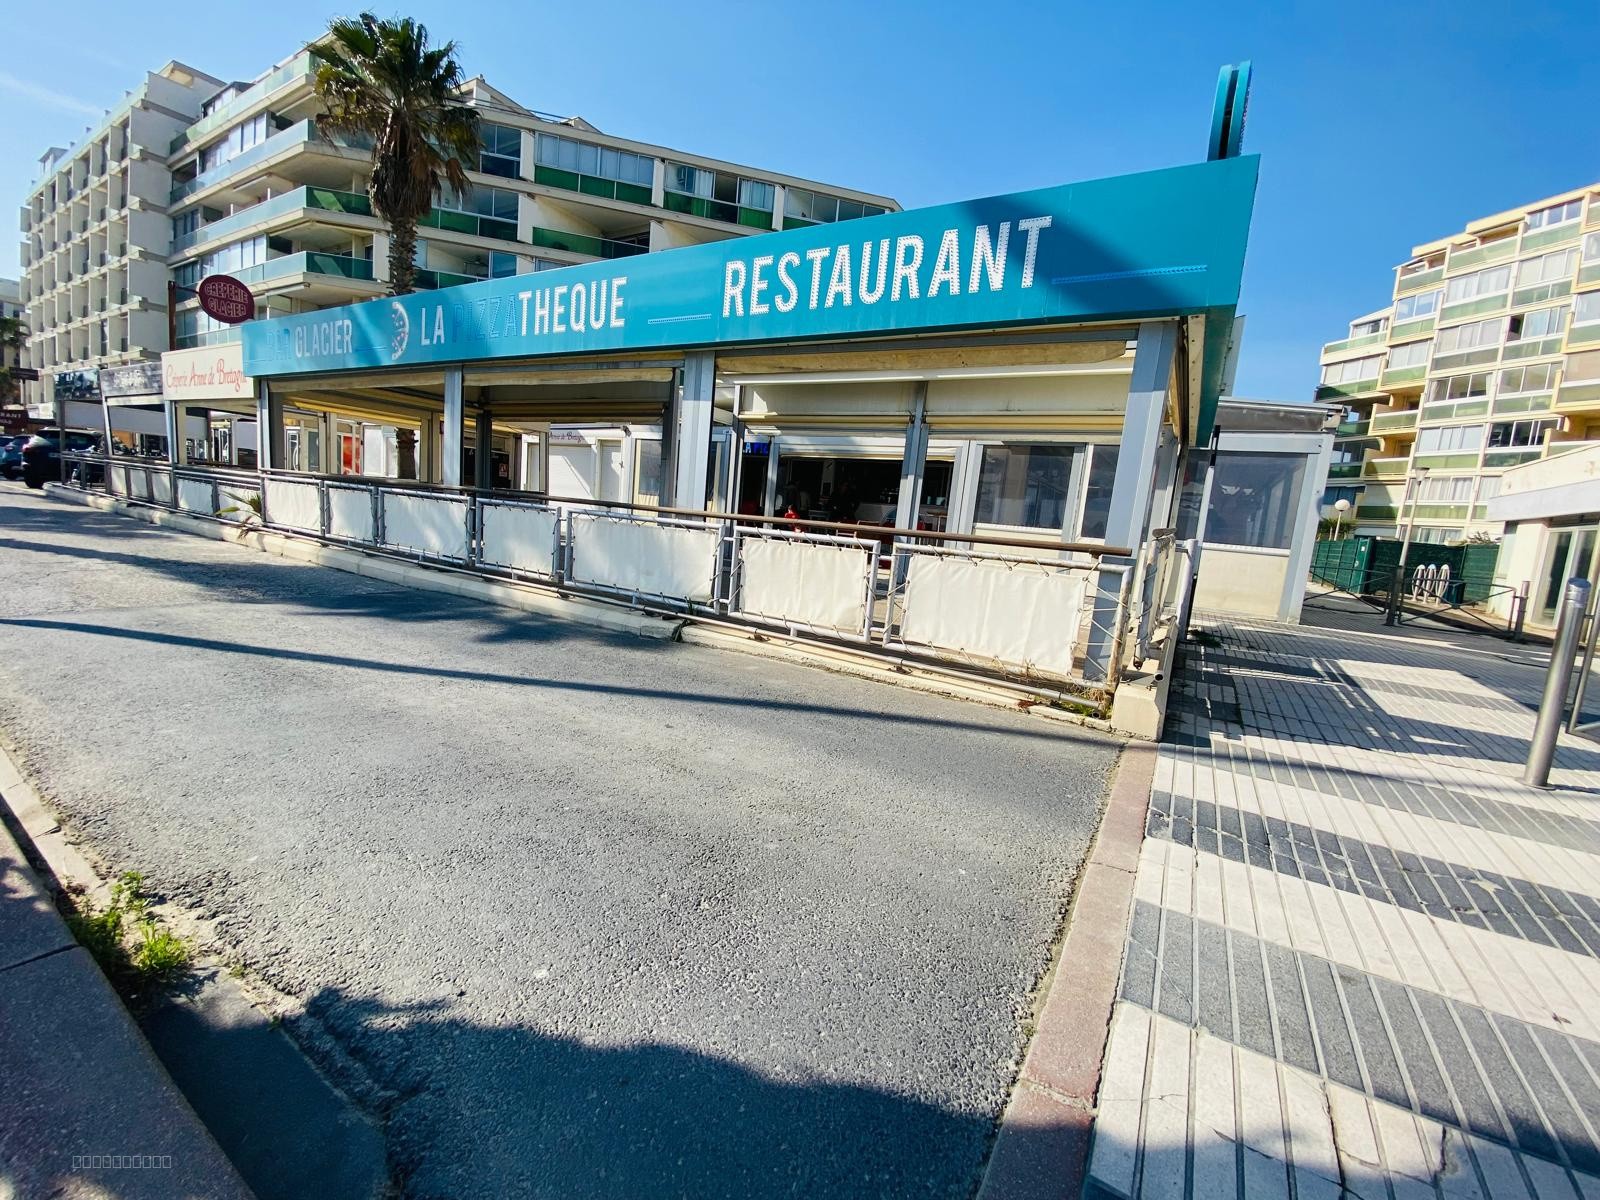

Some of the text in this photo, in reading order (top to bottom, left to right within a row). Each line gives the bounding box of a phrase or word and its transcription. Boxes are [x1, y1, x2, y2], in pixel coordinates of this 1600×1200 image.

[721, 215, 1053, 318] RESTAURANT
[208, 297, 247, 318] GLACIER
[420, 276, 628, 346] LA PIZZATHEQUE
[295, 319, 353, 358] GLACIER
